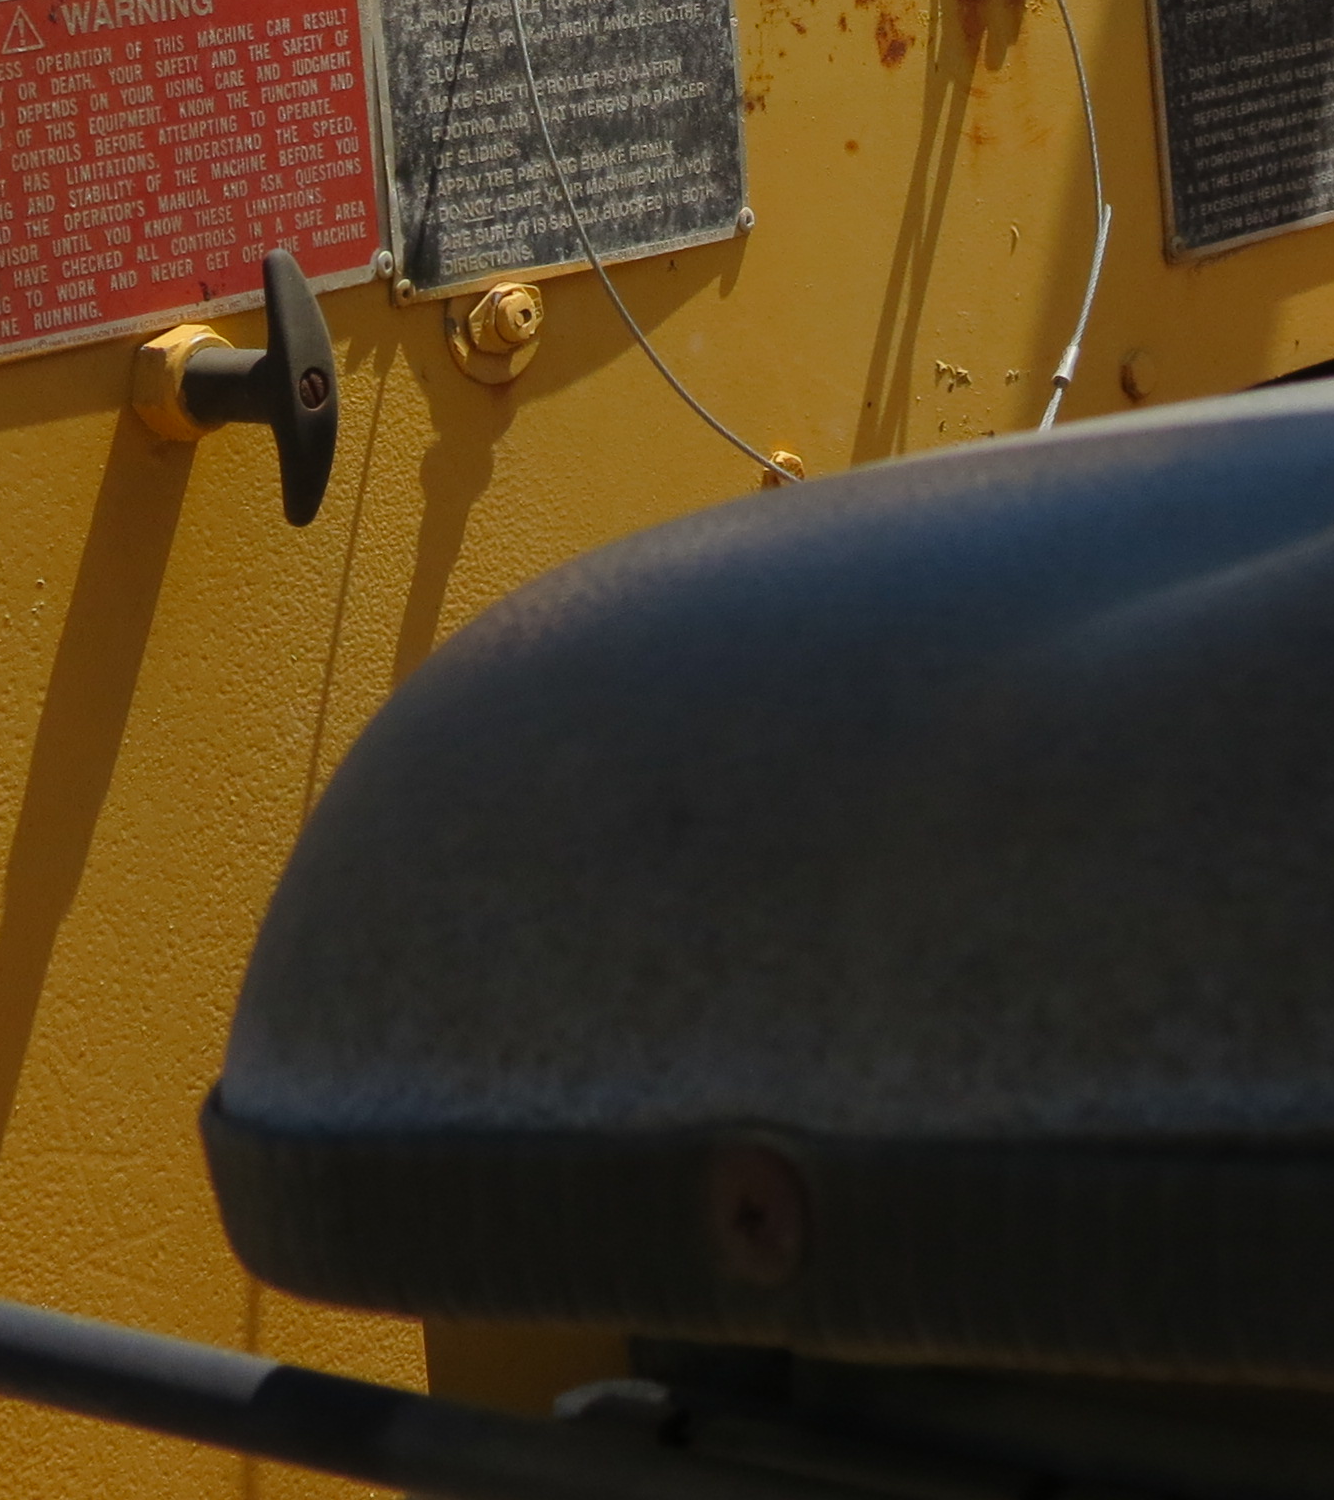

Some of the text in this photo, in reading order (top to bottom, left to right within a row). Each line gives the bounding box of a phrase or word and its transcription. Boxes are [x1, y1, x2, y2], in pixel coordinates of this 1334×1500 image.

[18, 81, 37, 100] OR
[50, 71, 95, 95] DEATH.
[108, 63, 142, 85] YOUR
[155, 54, 198, 78] SAFETY
[210, 48, 236, 68] AND
[248, 42, 271, 61] THE
[282, 33, 324, 56] SAFETY
[334, 28, 349, 47] OF
[32, 45, 112, 75] OPERATION
[125, 40, 142, 60] OF
[154, 34, 184, 55] THIS
[197, 20, 254, 48] MACHINE
[266, 16, 291, 36] CAN
[302, 7, 347, 30] RESULT
[15, 127, 33, 148] OF
[45, 120, 75, 142] THIS
[178, 96, 214, 118] KNOW
[226, 90, 249, 110] THE
[261, 78, 318, 104] FUNCTION
[329, 71, 353, 91] AND
[17, 97, 78, 124] DEPENDS
[89, 91, 108, 111] ON
[120, 84, 154, 106] YOUR
[165, 75, 203, 98] USING
[215, 68, 245, 90] CARE
[256, 62, 280, 82] AND
[291, 50, 351, 76] JUDGMENT
[474, 85, 514, 106] SURE
[652, 81, 706, 104] DANGER
[11, 142, 81, 172] CONTROLS
[95, 131, 145, 156] BEFORE
[158, 114, 237, 145] ATTEMPTING
[249, 109, 266, 128] TO
[23, 171, 50, 193] HAS
[66, 151, 159, 185] LIMITATIONS.
[174, 132, 262, 164] UNDERSTAND
[275, 124, 299, 145] THE
[435, 147, 626, 196] APPLY THE BRAKE
[33, 299, 102, 330] RUNNING.
